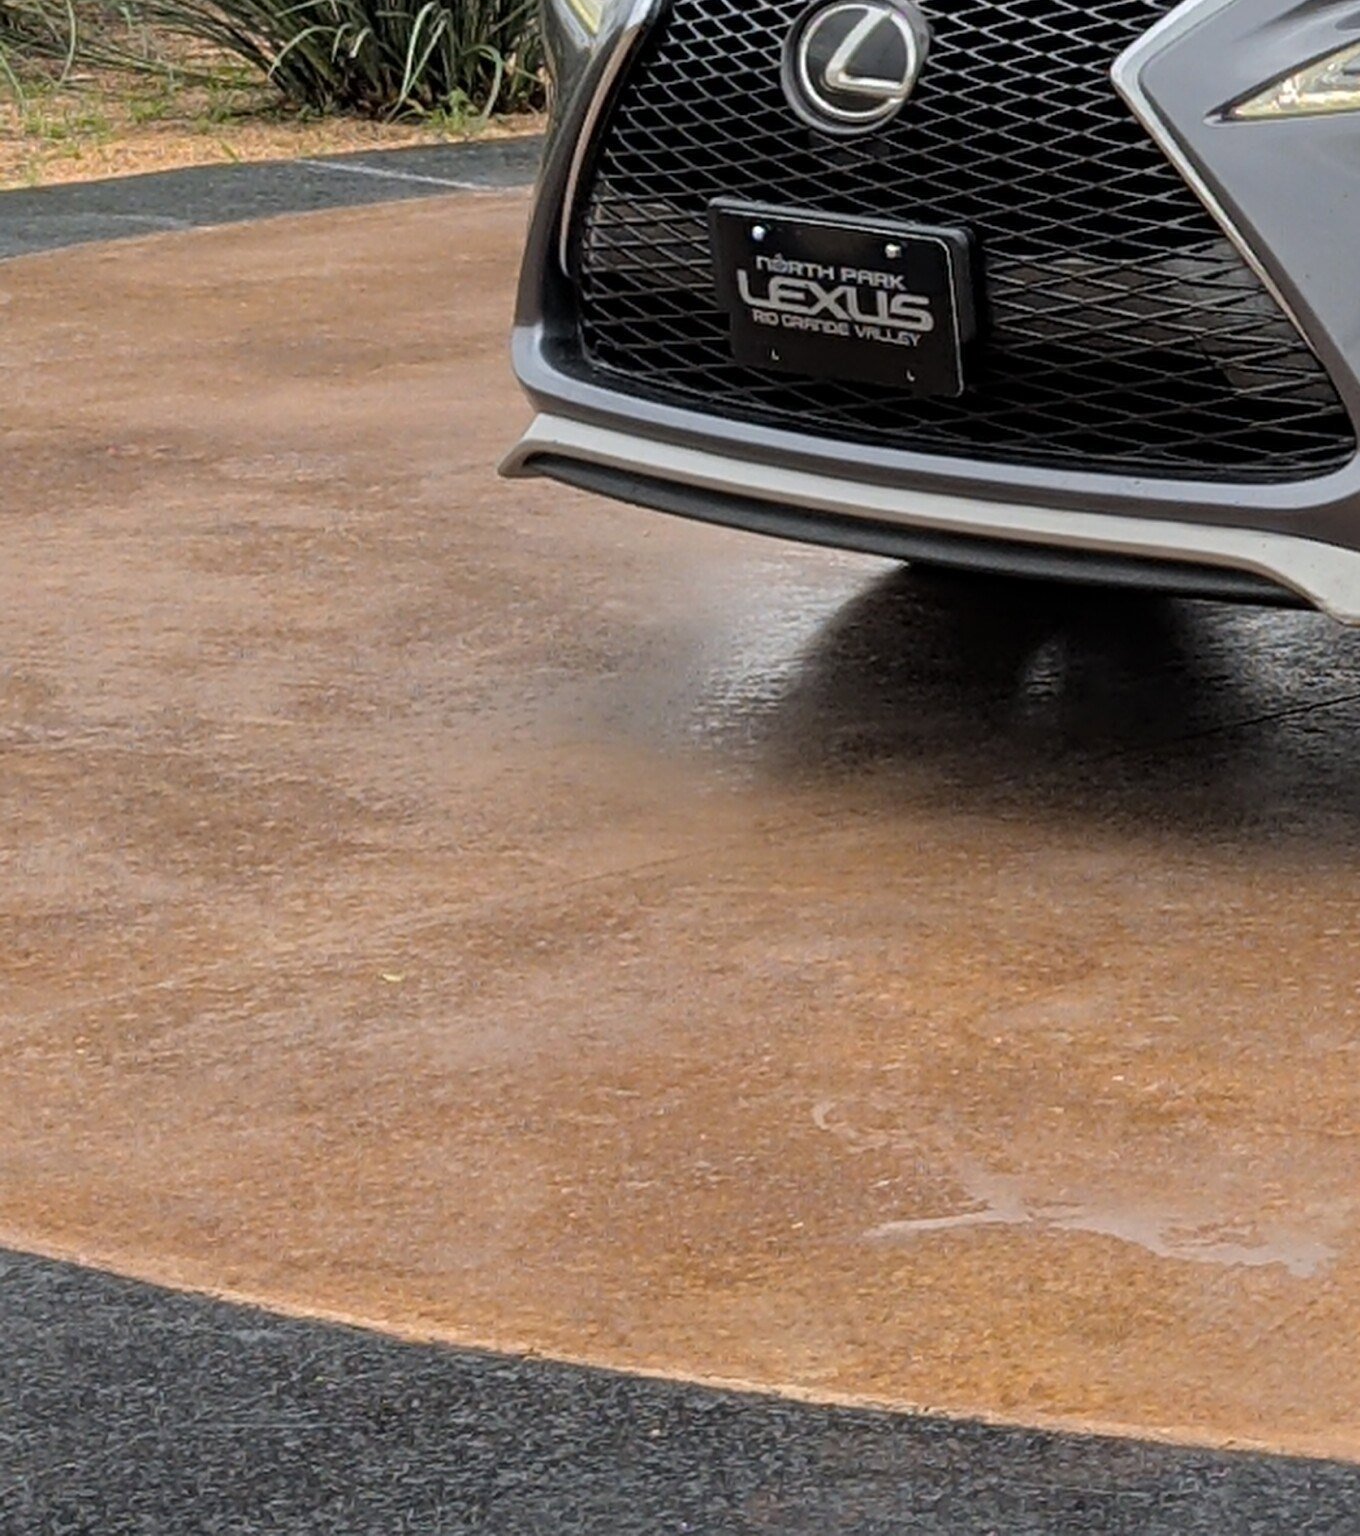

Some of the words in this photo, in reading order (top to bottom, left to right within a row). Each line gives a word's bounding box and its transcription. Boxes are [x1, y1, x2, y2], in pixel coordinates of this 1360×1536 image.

[756, 254, 835, 280] NORTH
[841, 267, 907, 291] PARK
[736, 269, 934, 332] LEXUS
[751, 308, 779, 326] RIO
[781, 313, 849, 336] GRANDE
[854, 324, 922, 347] VALLEY
